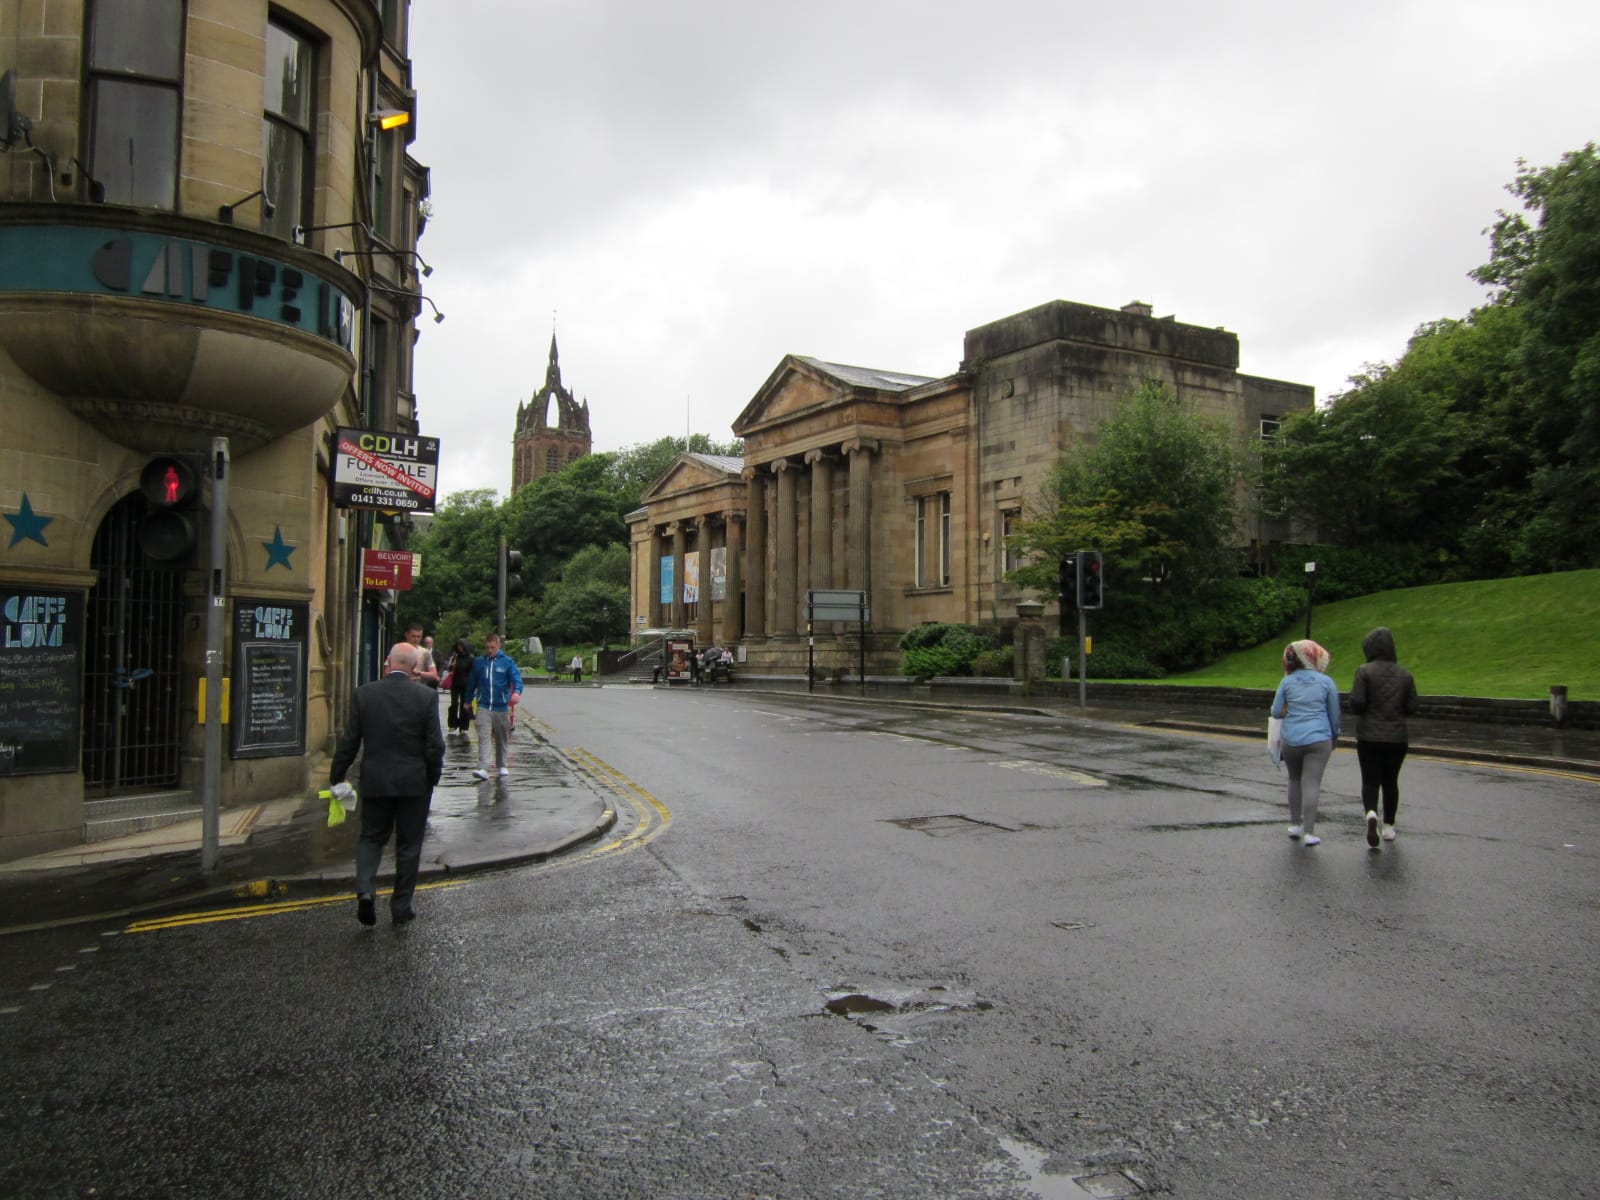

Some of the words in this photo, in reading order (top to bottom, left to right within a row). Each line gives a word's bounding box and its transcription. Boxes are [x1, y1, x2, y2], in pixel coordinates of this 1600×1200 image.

[359, 433, 418, 457] CDLH
[342, 440, 374, 464] OFFERS
[374, 459, 397, 476] NOW
[396, 472, 431, 496] INVITED
[351, 493, 374, 504] 0141
[376, 496, 393, 506] 331
[395, 498, 418, 509] 0650
[363, 486, 408, 498] cdlh.co.uk
[365, 577, 374, 585] To
[375, 578, 388, 586] Let
[4, 595, 67, 623] CAFFE
[255, 606, 293, 626] CAFFE
[4, 623, 64, 649] LUNA
[255, 622, 290, 640] LUNA
